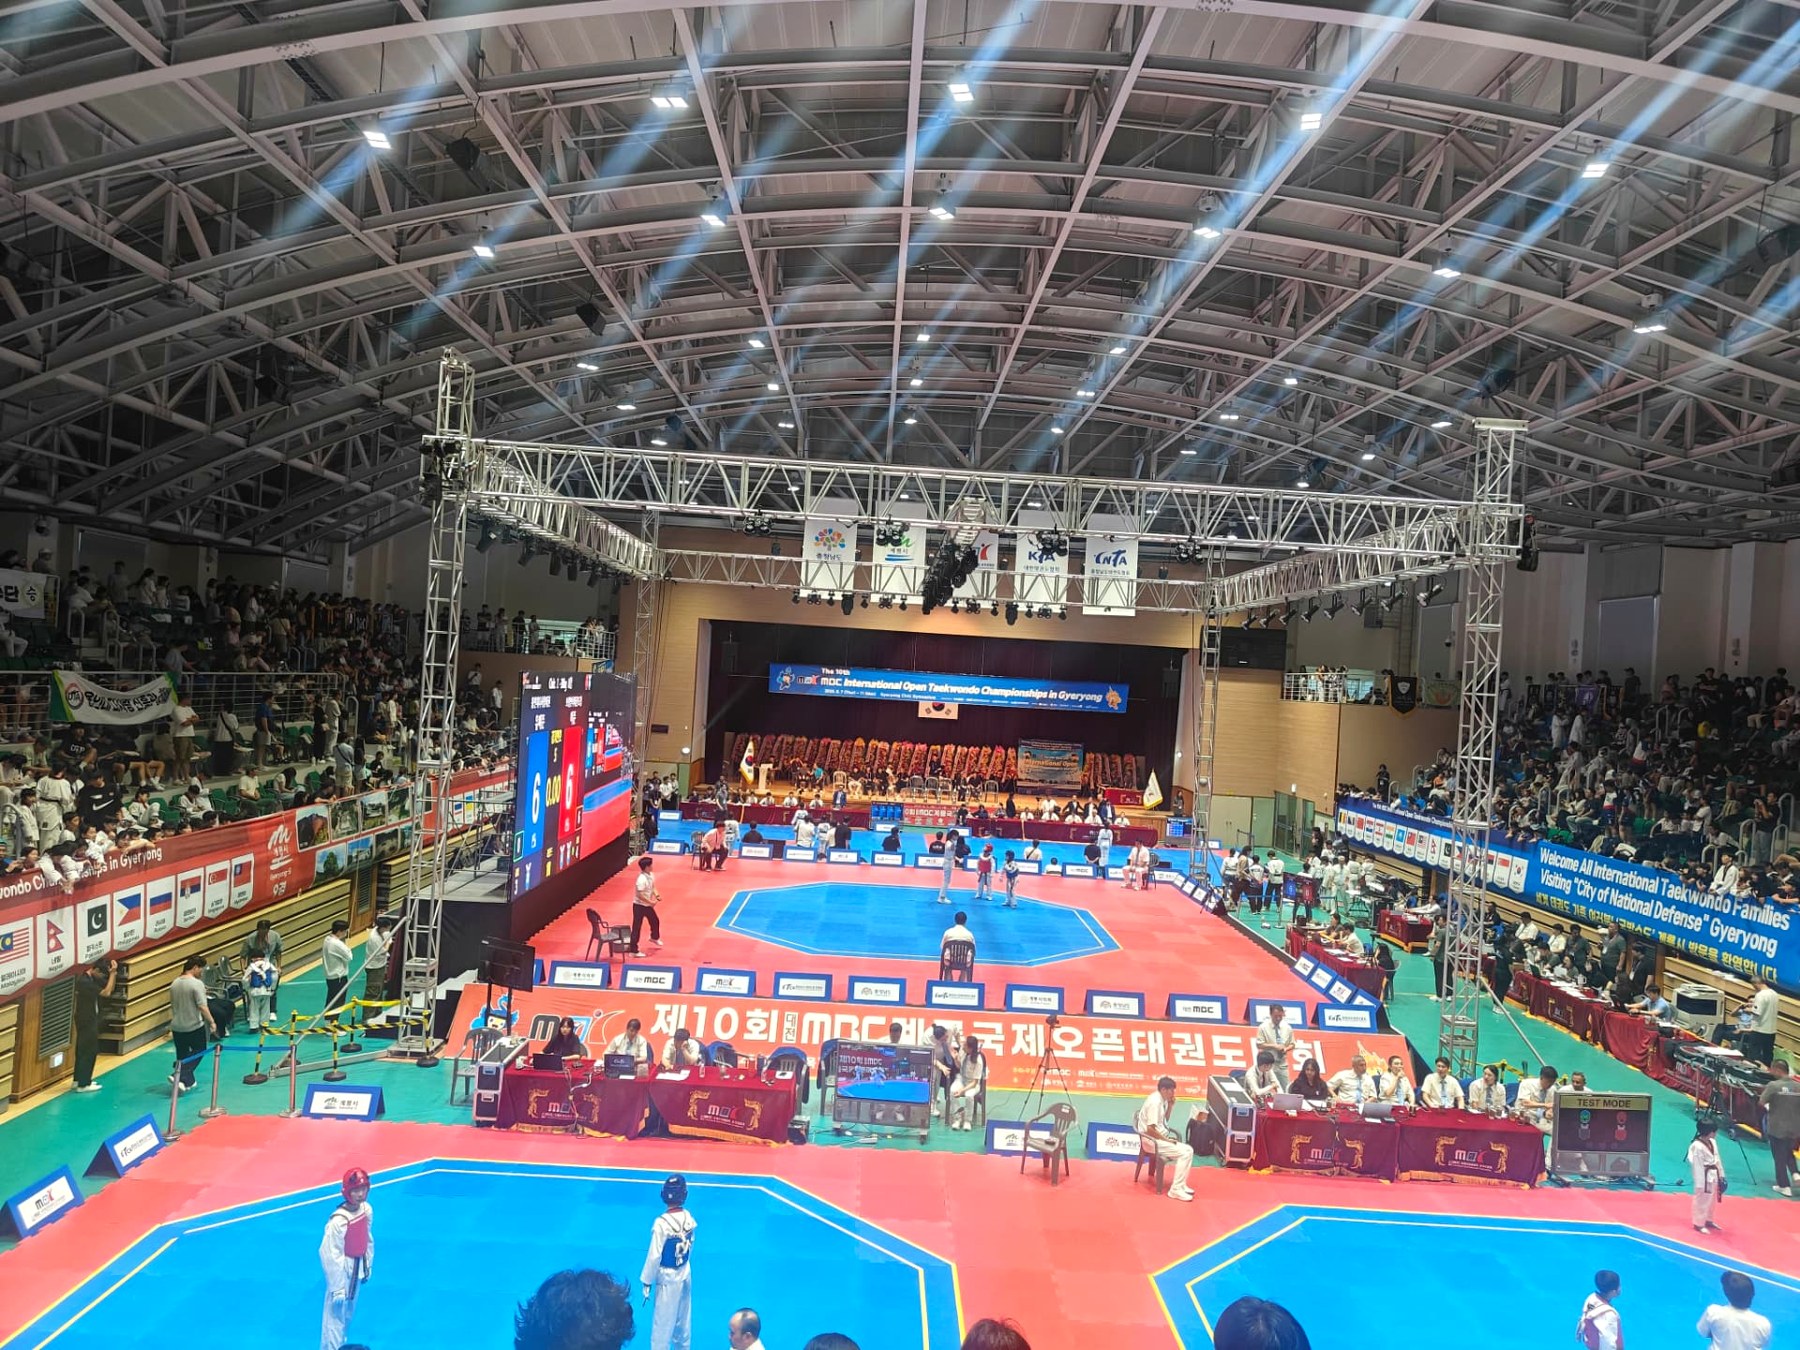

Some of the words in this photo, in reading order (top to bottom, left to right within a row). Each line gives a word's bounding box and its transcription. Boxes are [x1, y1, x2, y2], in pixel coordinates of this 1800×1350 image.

[844, 678, 902, 691] International
[903, 681, 927, 693] Open
[929, 683, 979, 694] Taekwondo
[981, 686, 1049, 700] Championships
[532, 772, 541, 825] 6
[565, 764, 573, 810] 6
[110, 856, 119, 870] in
[120, 848, 163, 869] Gyeryong
[1540, 847, 1579, 873] Welcome
[1579, 858, 1592, 877] All
[1592, 861, 1659, 895] International
[1661, 877, 1731, 914] Taekwondo
[1732, 900, 1791, 931] Families
[1540, 868, 1572, 895] Visiting
[1574, 876, 1597, 902] "City
[1597, 886, 1610, 904] of
[1609, 888, 1654, 918] National
[1653, 900, 1710, 932] Defense"
[1709, 917, 1778, 959] Gyeryong
[1535, 891, 1549, 906] 세계
[1550, 896, 1571, 914] 태권도
[1572, 903, 1587, 919] 가족
[1658, 931, 1686, 952] 계룡시
[1688, 940, 1719, 963] 방문을
[1721, 951, 1778, 984] 환영합니다
[650, 1003, 779, 1043] 제10회
[1577, 1098, 1600, 1107] TEST
[1603, 1099, 1631, 1108] MODE
